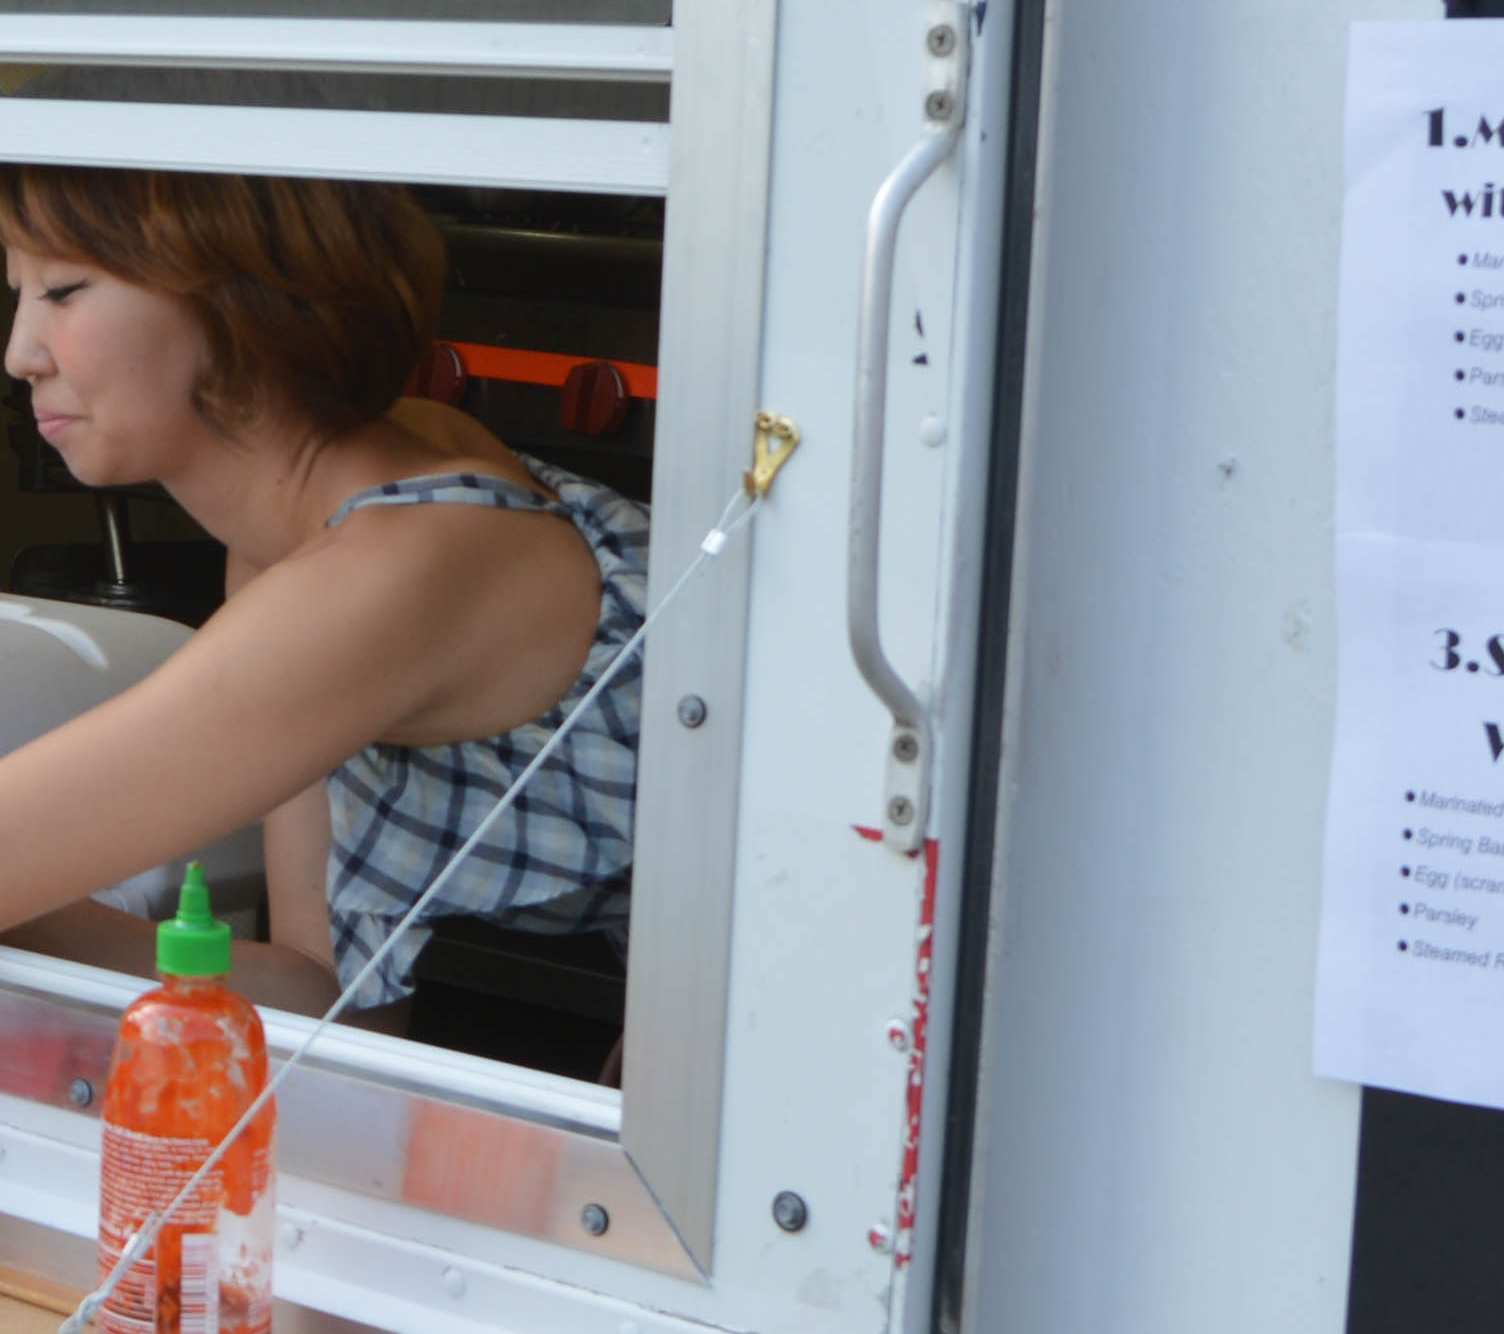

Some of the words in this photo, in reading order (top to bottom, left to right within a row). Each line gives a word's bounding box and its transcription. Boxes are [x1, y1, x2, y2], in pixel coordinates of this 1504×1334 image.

[1415, 825, 1475, 857] Spring
[1412, 863, 1451, 892] Egg
[1412, 901, 1479, 933] Parsley
[1411, 937, 1492, 970] Steamed
